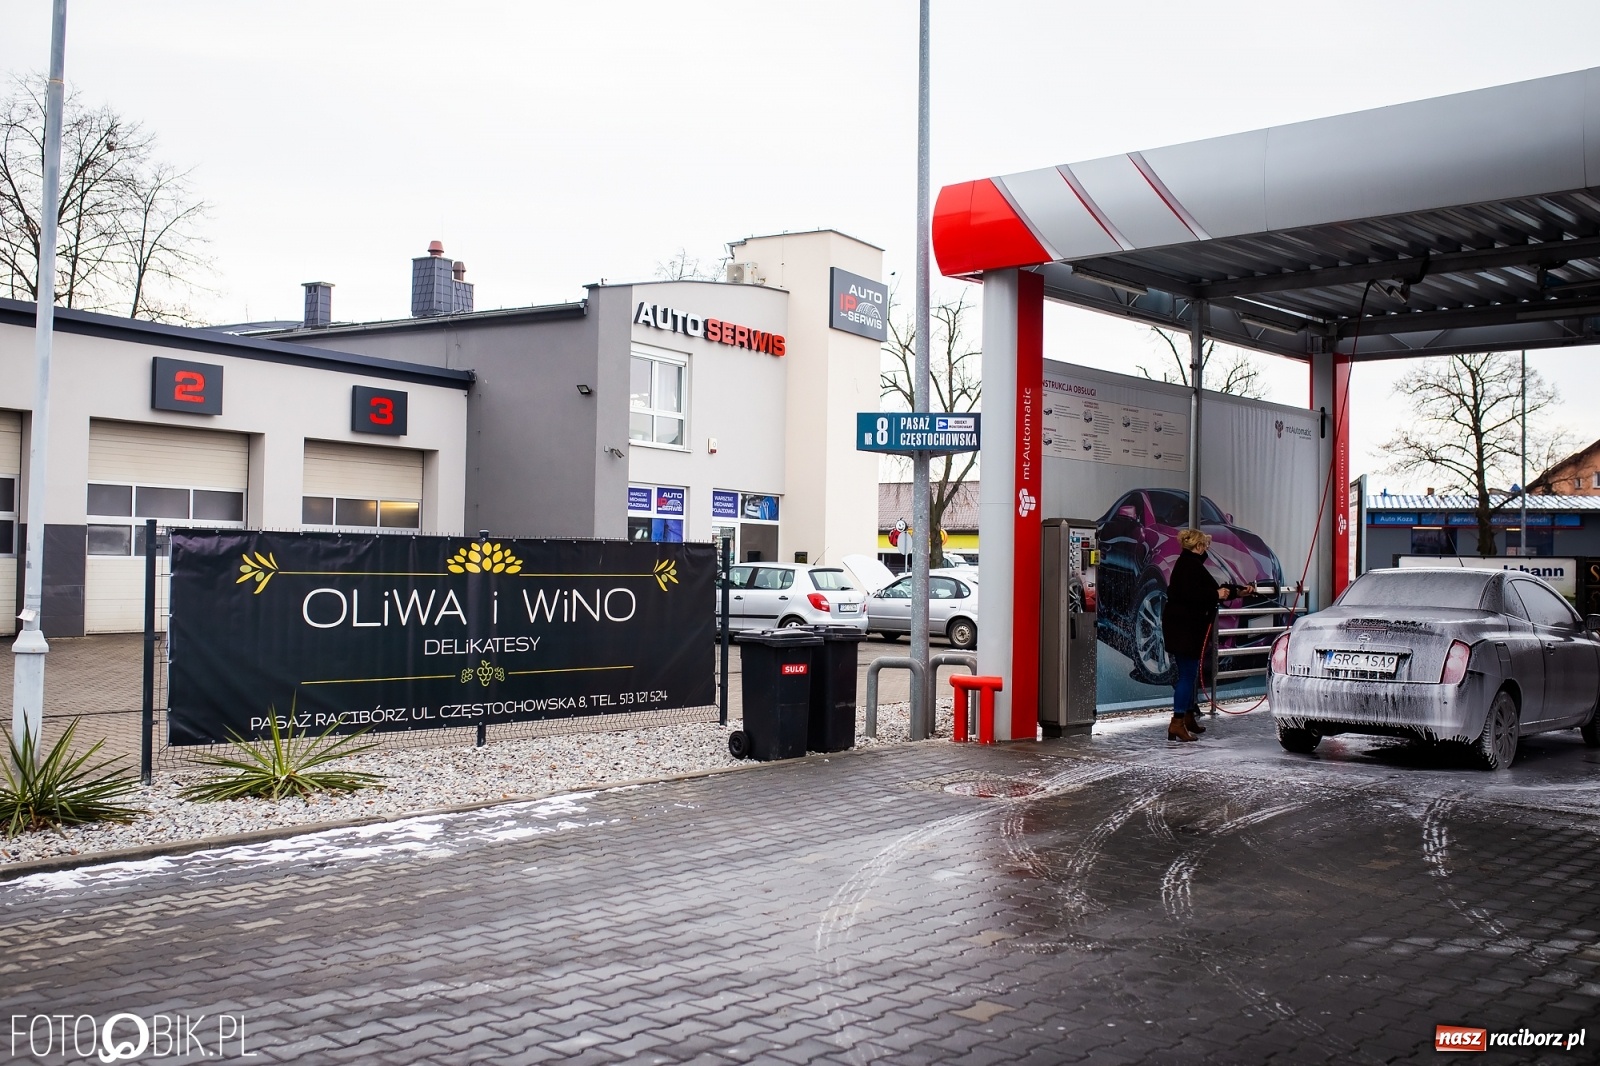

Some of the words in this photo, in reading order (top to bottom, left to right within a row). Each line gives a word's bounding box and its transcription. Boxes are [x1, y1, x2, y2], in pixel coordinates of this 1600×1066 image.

[840, 293, 857, 311] IP
[849, 284, 883, 304] AUTO
[634, 301, 702, 338] AUTO
[705, 318, 786, 357] SERWIS
[848, 310, 883, 329] SERWIS
[174, 370, 206, 403] 2
[1042, 379, 1073, 393] NSTRUKCJA
[369, 397, 394, 425] 3
[876, 417, 888, 445] 8
[900, 416, 930, 430] PASAŻ
[900, 432, 977, 447] CZĘSTOCHOWSKA
[1022, 387, 1032, 480] mtAutomatic
[785, 665, 805, 673] SULO
[1333, 653, 1360, 667] SRC
[1365, 655, 1395, 669] 1SA9
[250, 711, 312, 731] PASAŻ
[315, 705, 409, 727] RACIBÓRZ,
[439, 696, 576, 719] CZĘSTOCHOWSKA
[578, 696, 588, 709] 8,
[619, 692, 635, 705] 513
[636, 691, 649, 703] 121
[649, 690, 668, 702] 524
